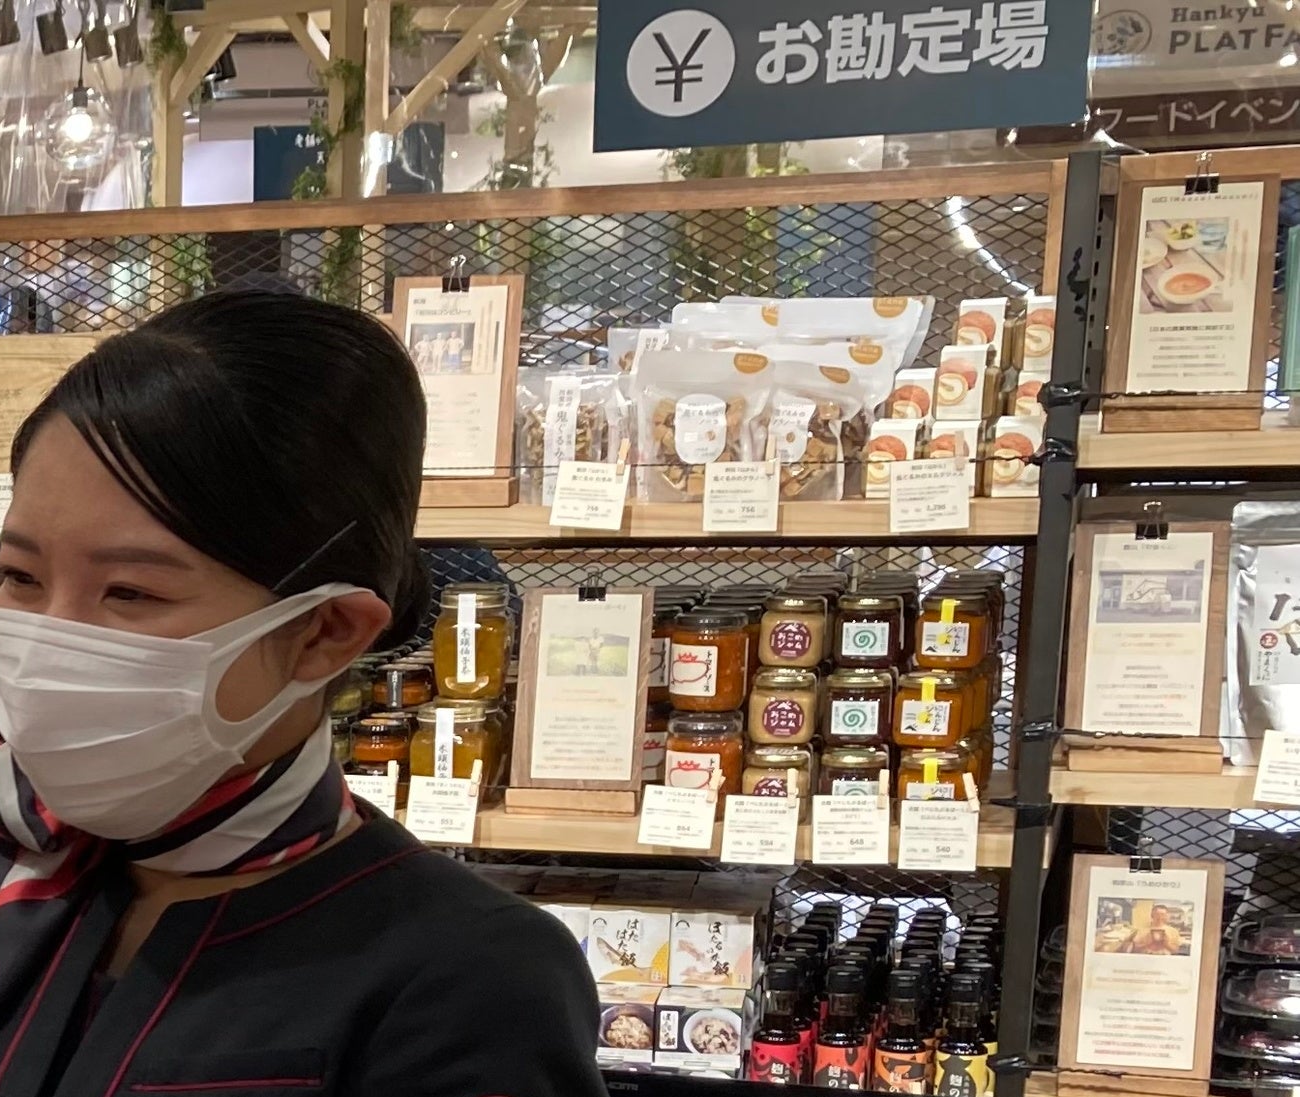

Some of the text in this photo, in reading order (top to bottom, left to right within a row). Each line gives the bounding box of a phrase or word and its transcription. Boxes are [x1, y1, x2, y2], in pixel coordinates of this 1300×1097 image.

[1170, 5, 1267, 23] Hankyu
[756, 0, 1050, 85] お勘定場
[1169, 28, 1258, 54] PLAT
